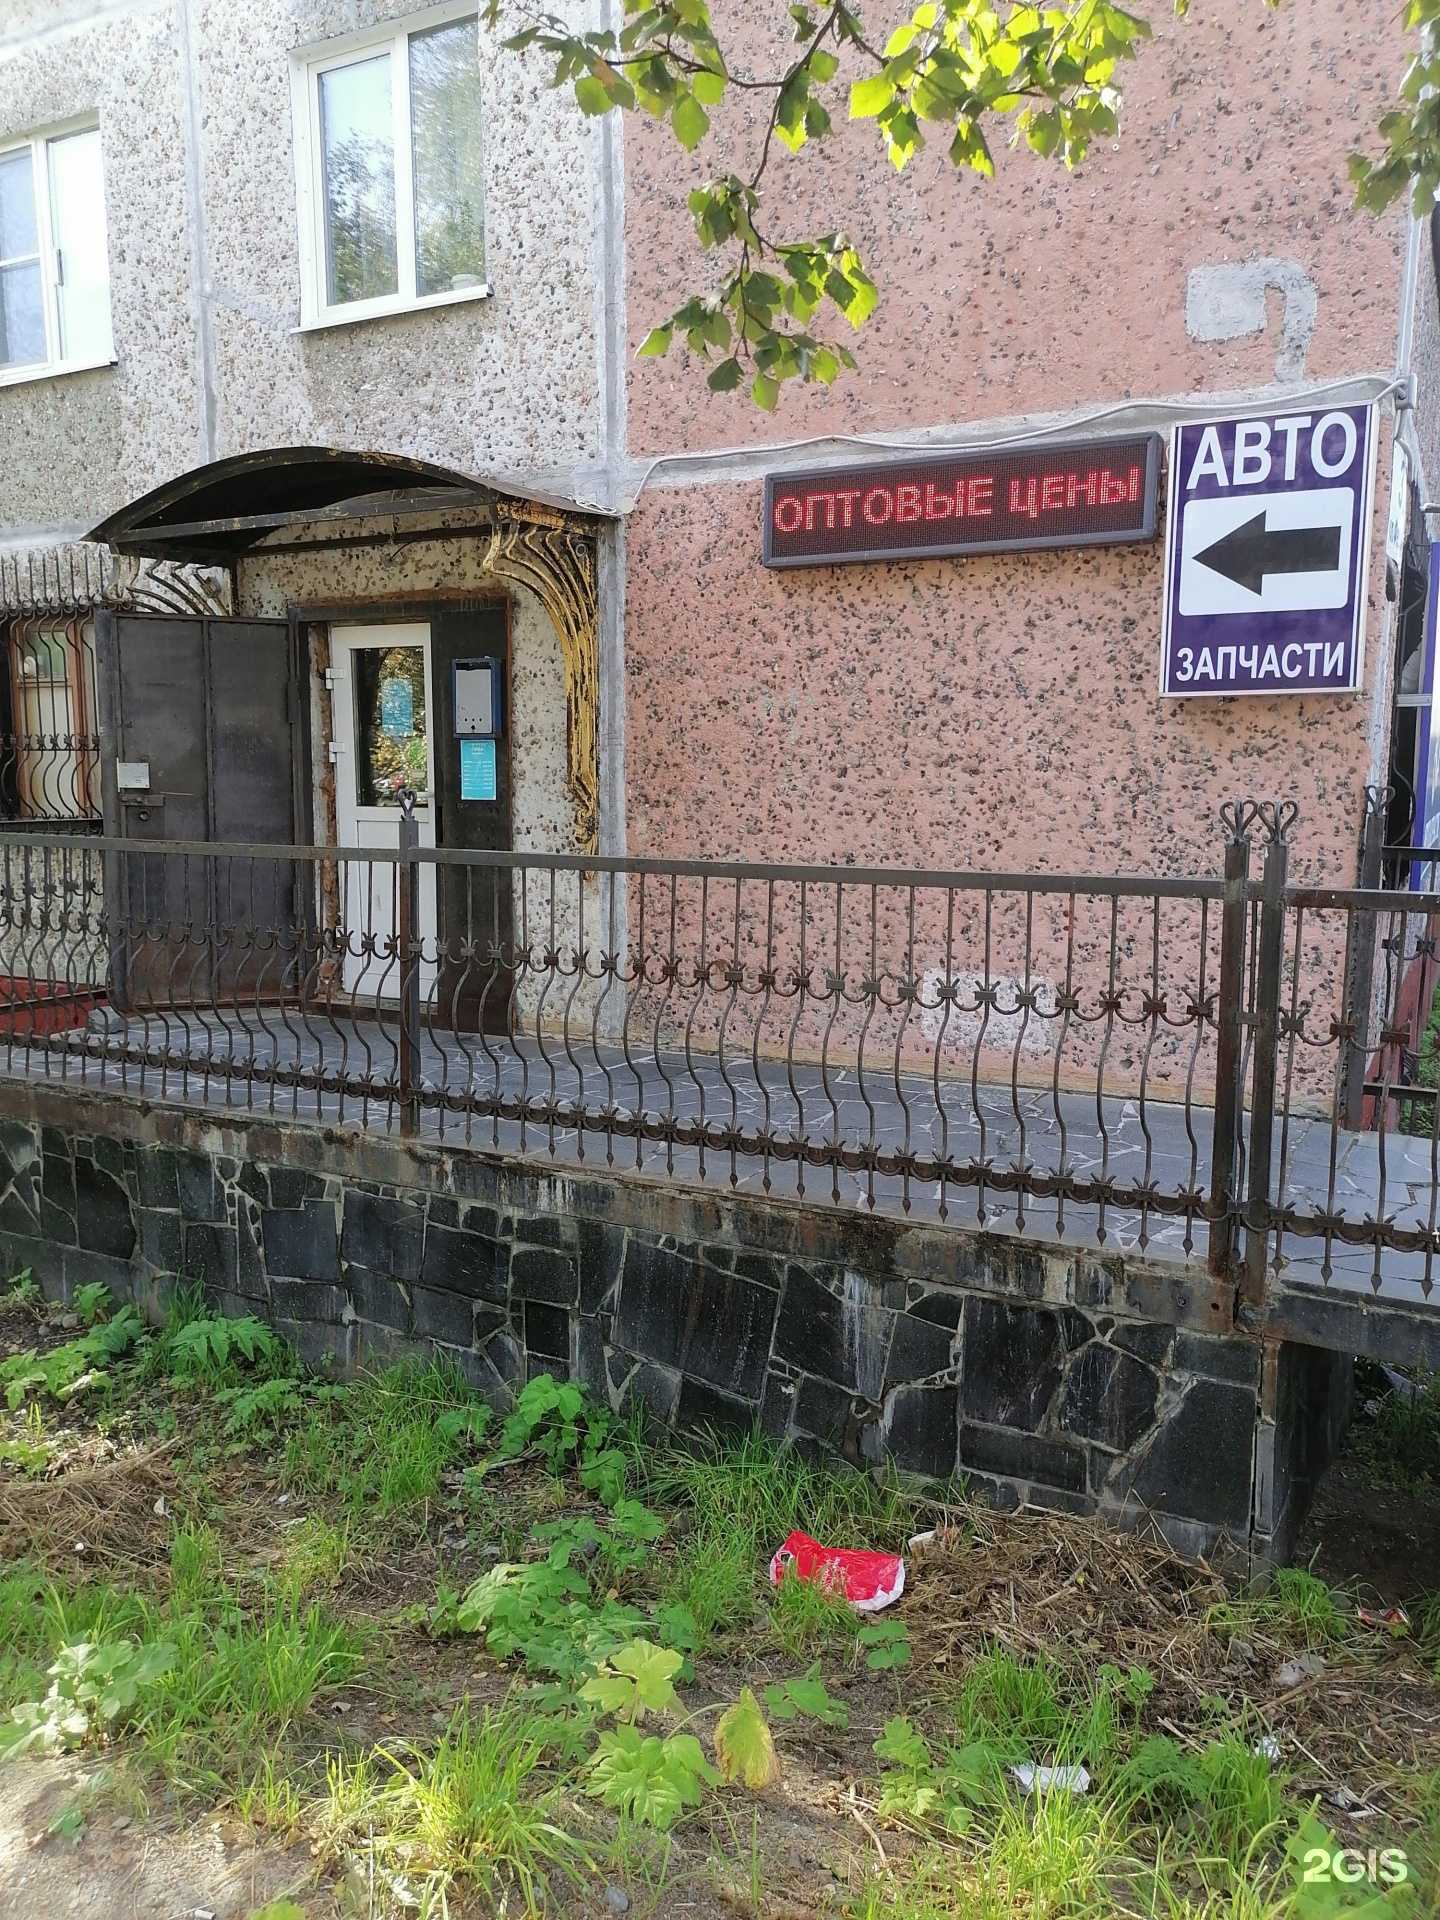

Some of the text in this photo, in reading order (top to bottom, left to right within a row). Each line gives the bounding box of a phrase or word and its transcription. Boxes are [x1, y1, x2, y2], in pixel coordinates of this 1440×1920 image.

[1185, 411, 1357, 490] АВТО
[774, 466, 1140, 532] ОПТОВЫЕ ЦЕНЫ
[1175, 641, 1345, 682] ЗАПЧАСТИ
